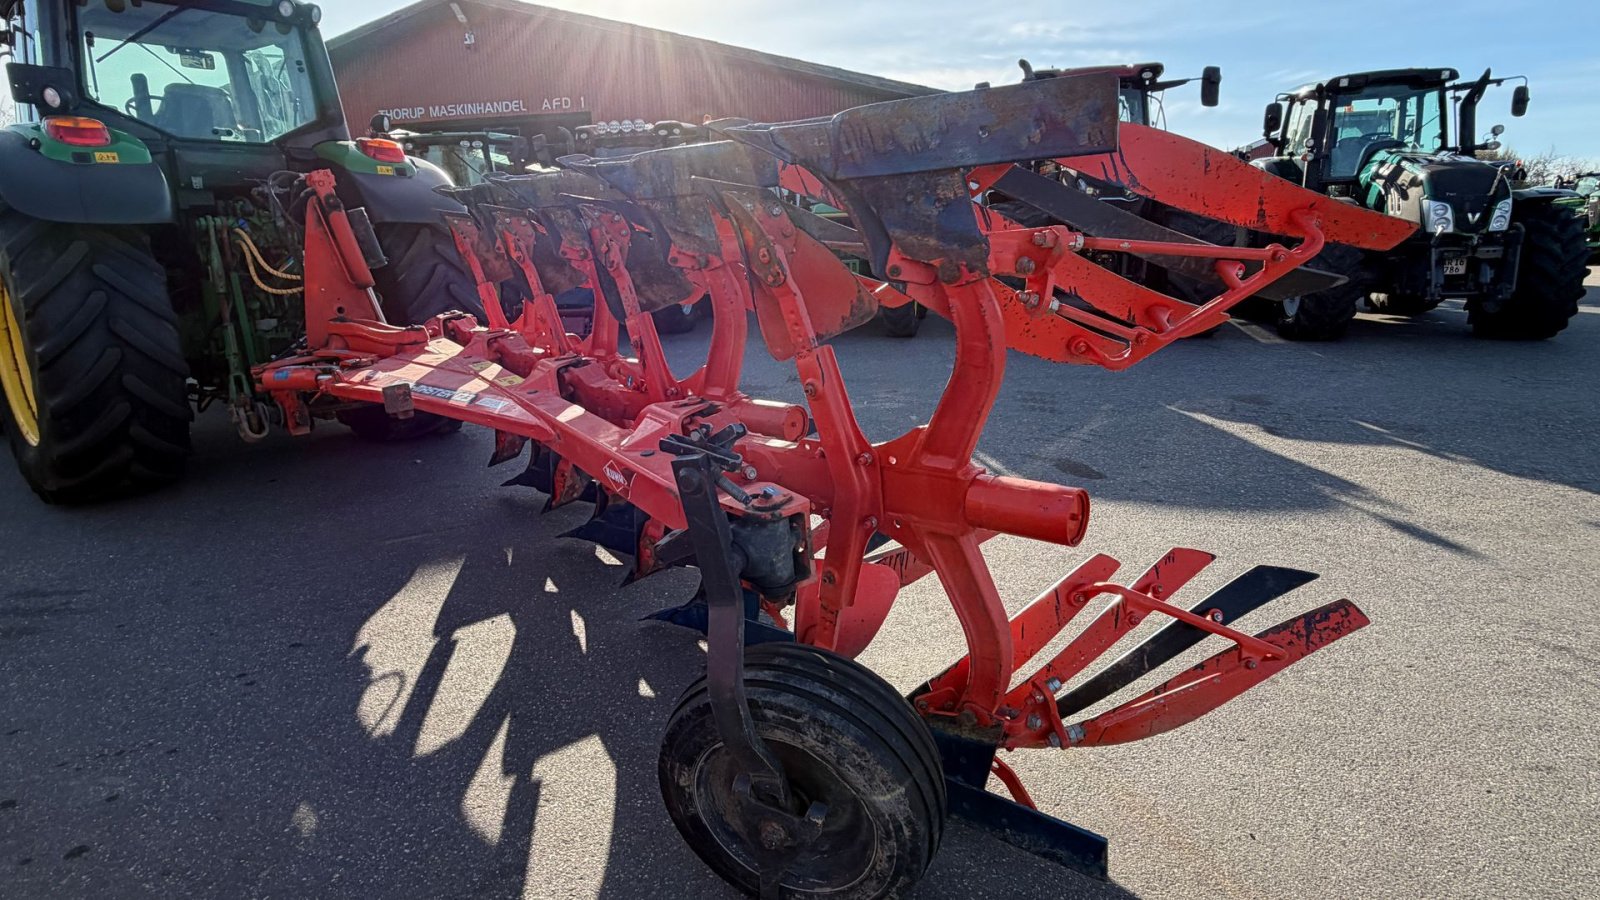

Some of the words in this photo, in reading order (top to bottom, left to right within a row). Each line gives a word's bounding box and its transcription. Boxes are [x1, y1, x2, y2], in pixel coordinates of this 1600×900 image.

[429, 100, 527, 118] MASKINHANDEL
[542, 97, 571, 111] AFD
[580, 96, 586, 109] 1
